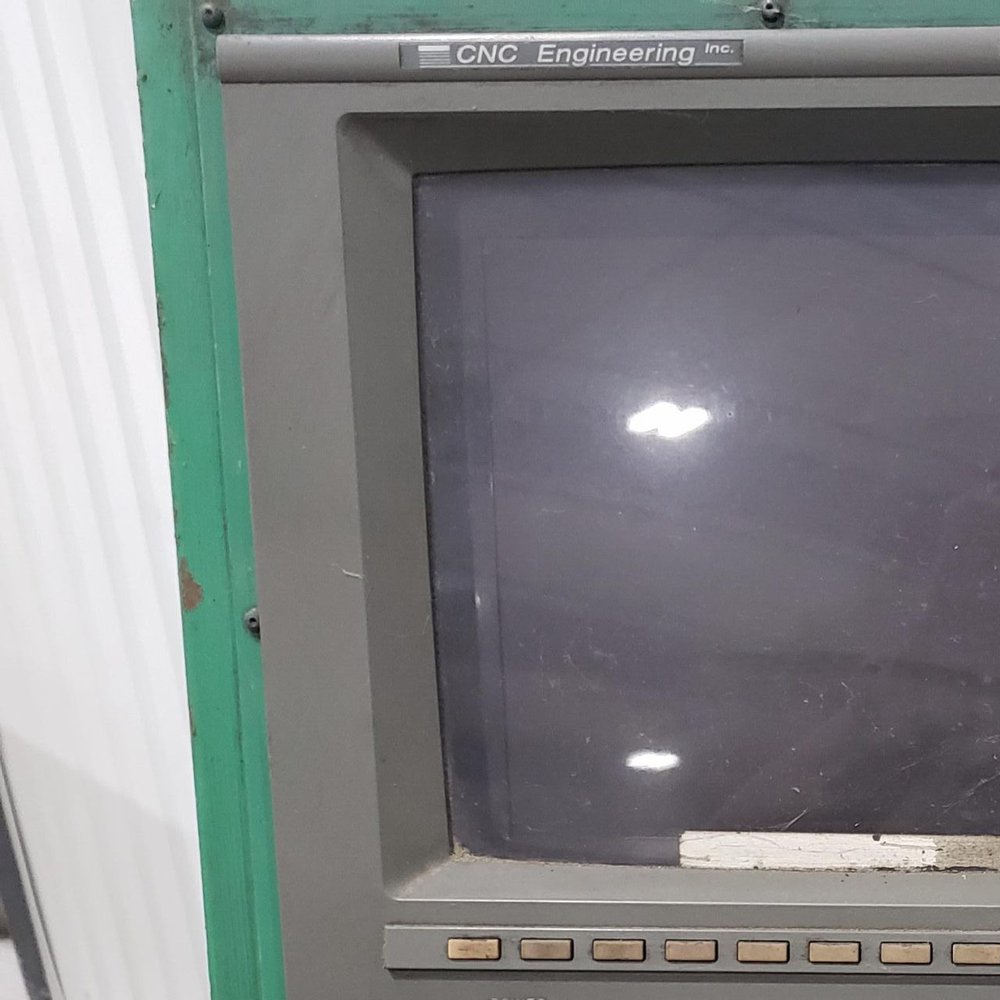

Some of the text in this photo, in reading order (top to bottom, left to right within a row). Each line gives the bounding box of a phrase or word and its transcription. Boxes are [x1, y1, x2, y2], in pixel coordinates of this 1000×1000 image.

[456, 42, 734, 68] CNC Engineering Inc.
